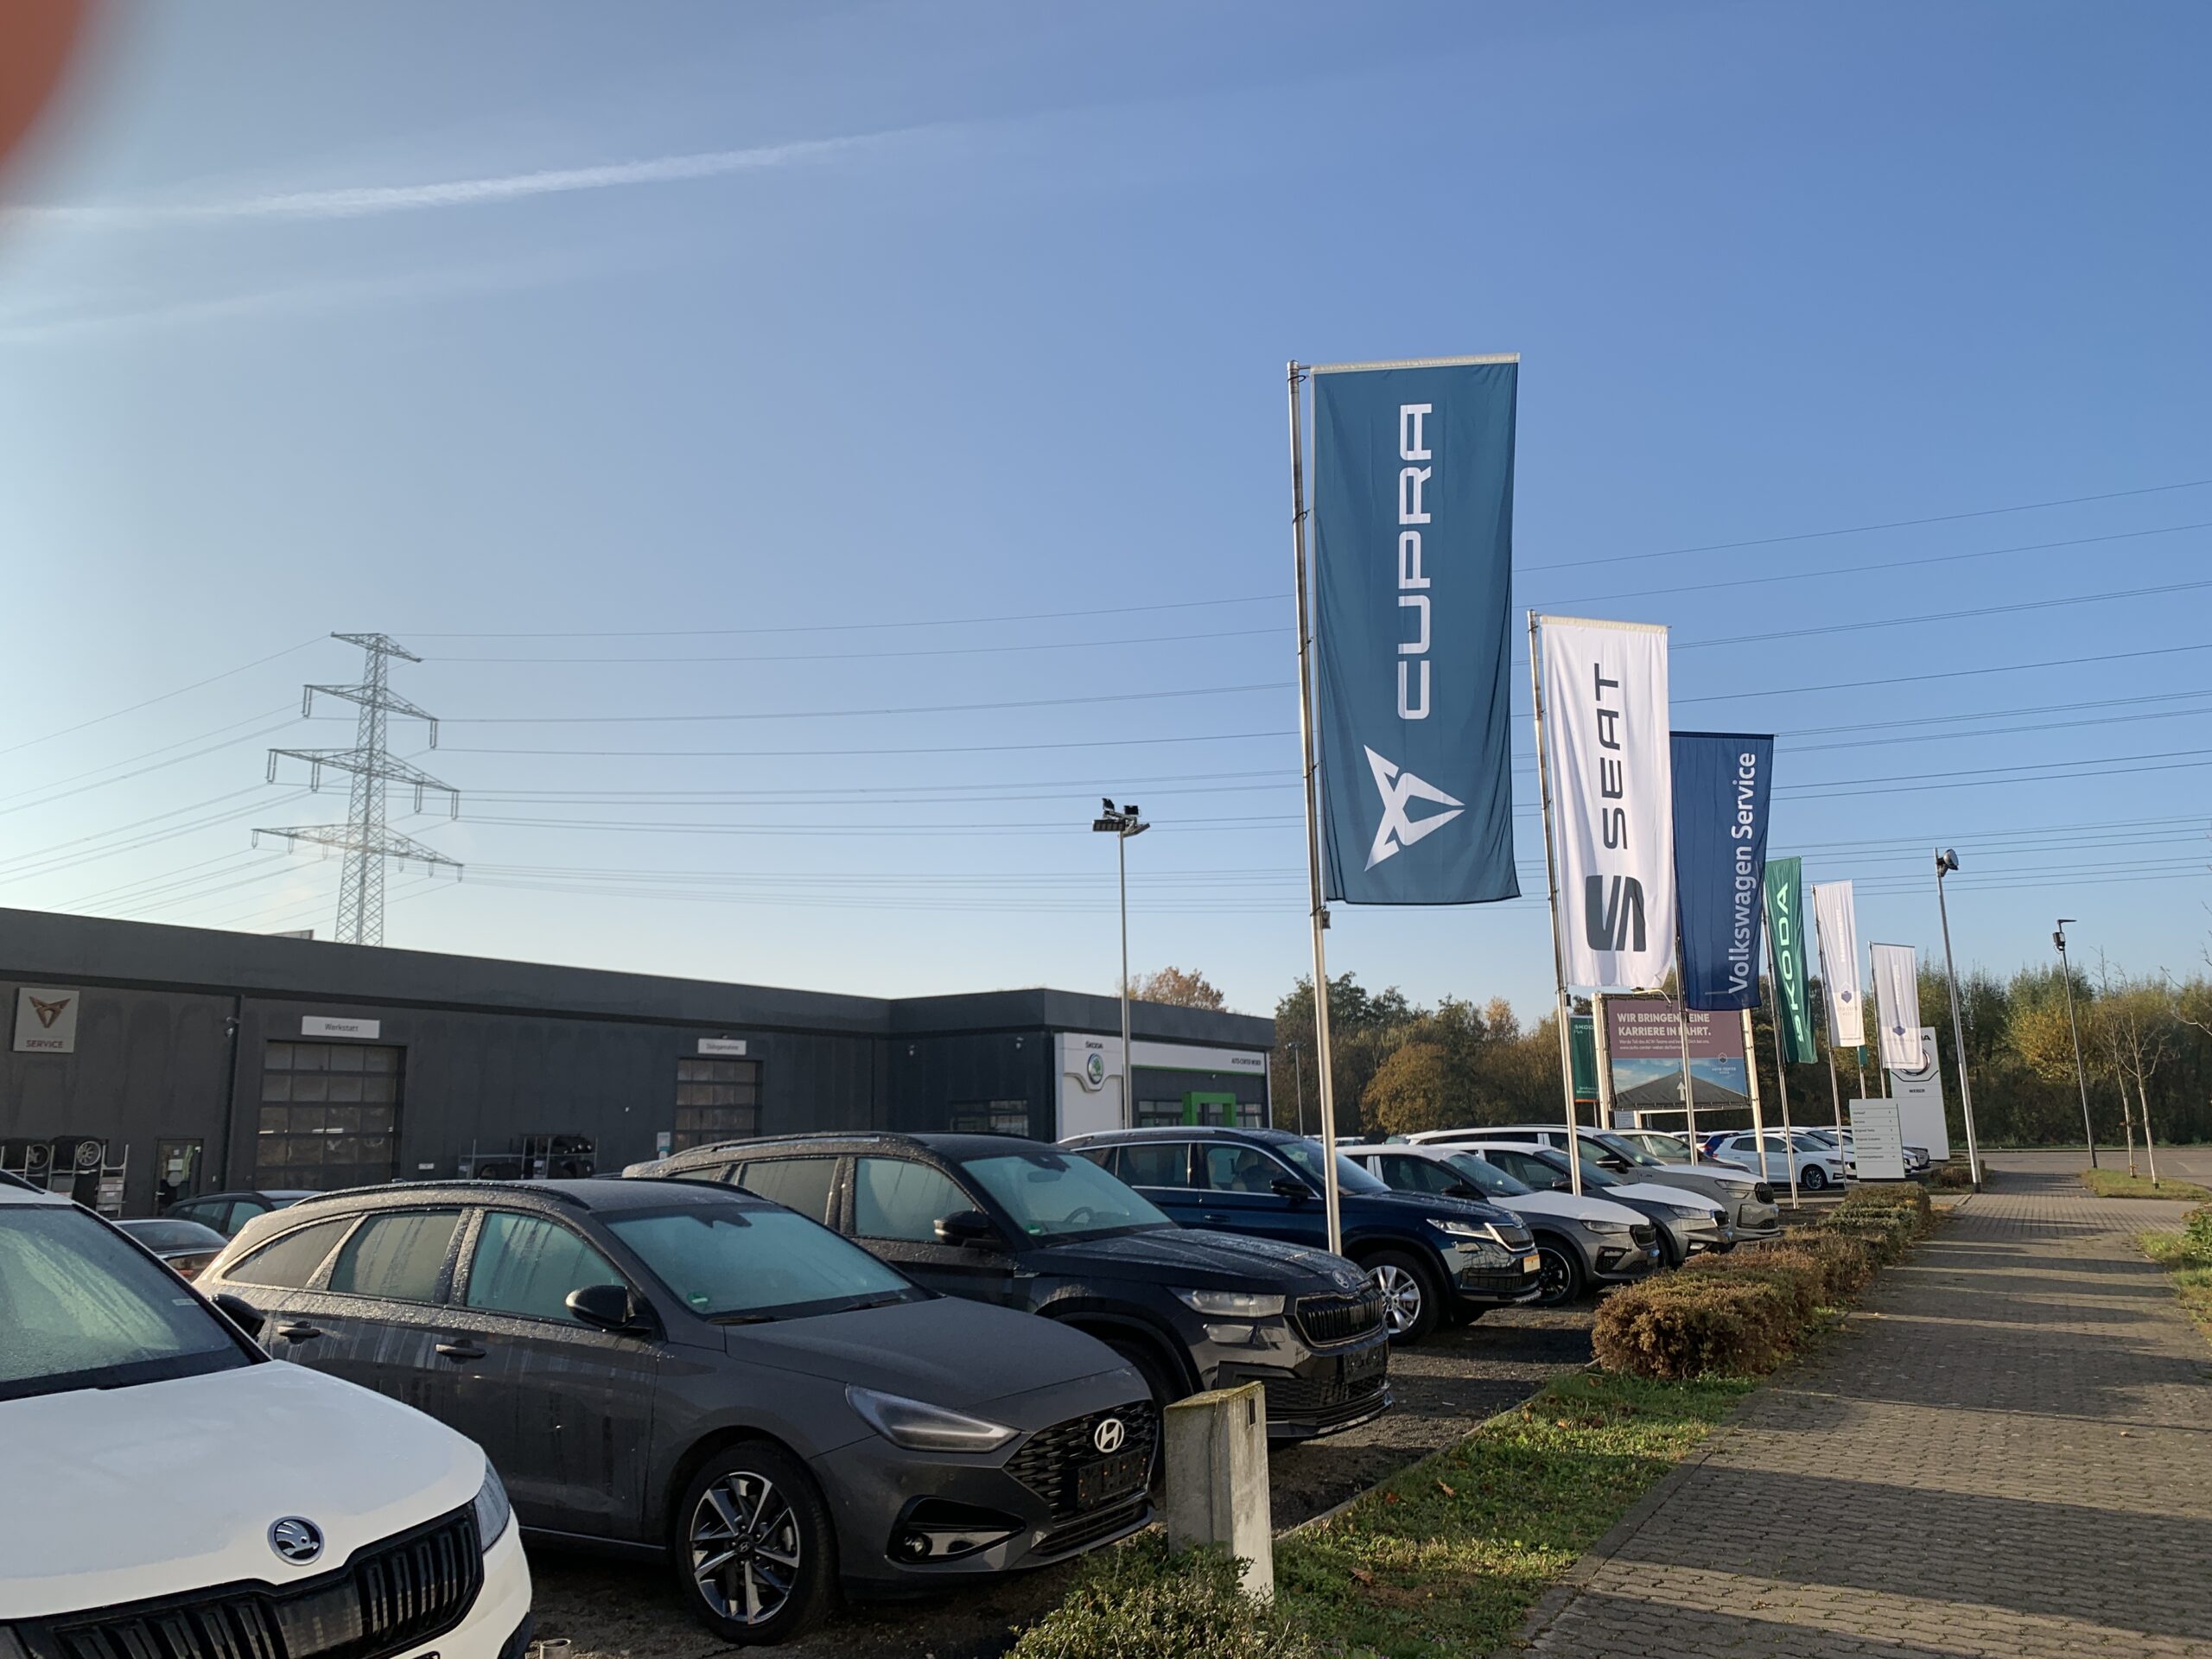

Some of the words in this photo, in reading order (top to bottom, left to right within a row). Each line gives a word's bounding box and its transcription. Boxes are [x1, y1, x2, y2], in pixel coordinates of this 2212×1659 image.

[1397, 402, 1433, 721] CUPRA
[1593, 663, 1628, 849] SEAT
[1731, 753, 1756, 840] Service
[1727, 846, 1757, 994] Volkswagen
[325, 1023, 359, 1032] Werkstatt
[1617, 1013, 1637, 1022] WIR
[1638, 1013, 1681, 1022] BRINGEN
[1688, 1014, 1710, 1022] EINE
[1618, 1027, 1665, 1036] KARRIERE
[1667, 1027, 1676, 1036] IN
[26, 1039, 63, 1049] SERVICE
